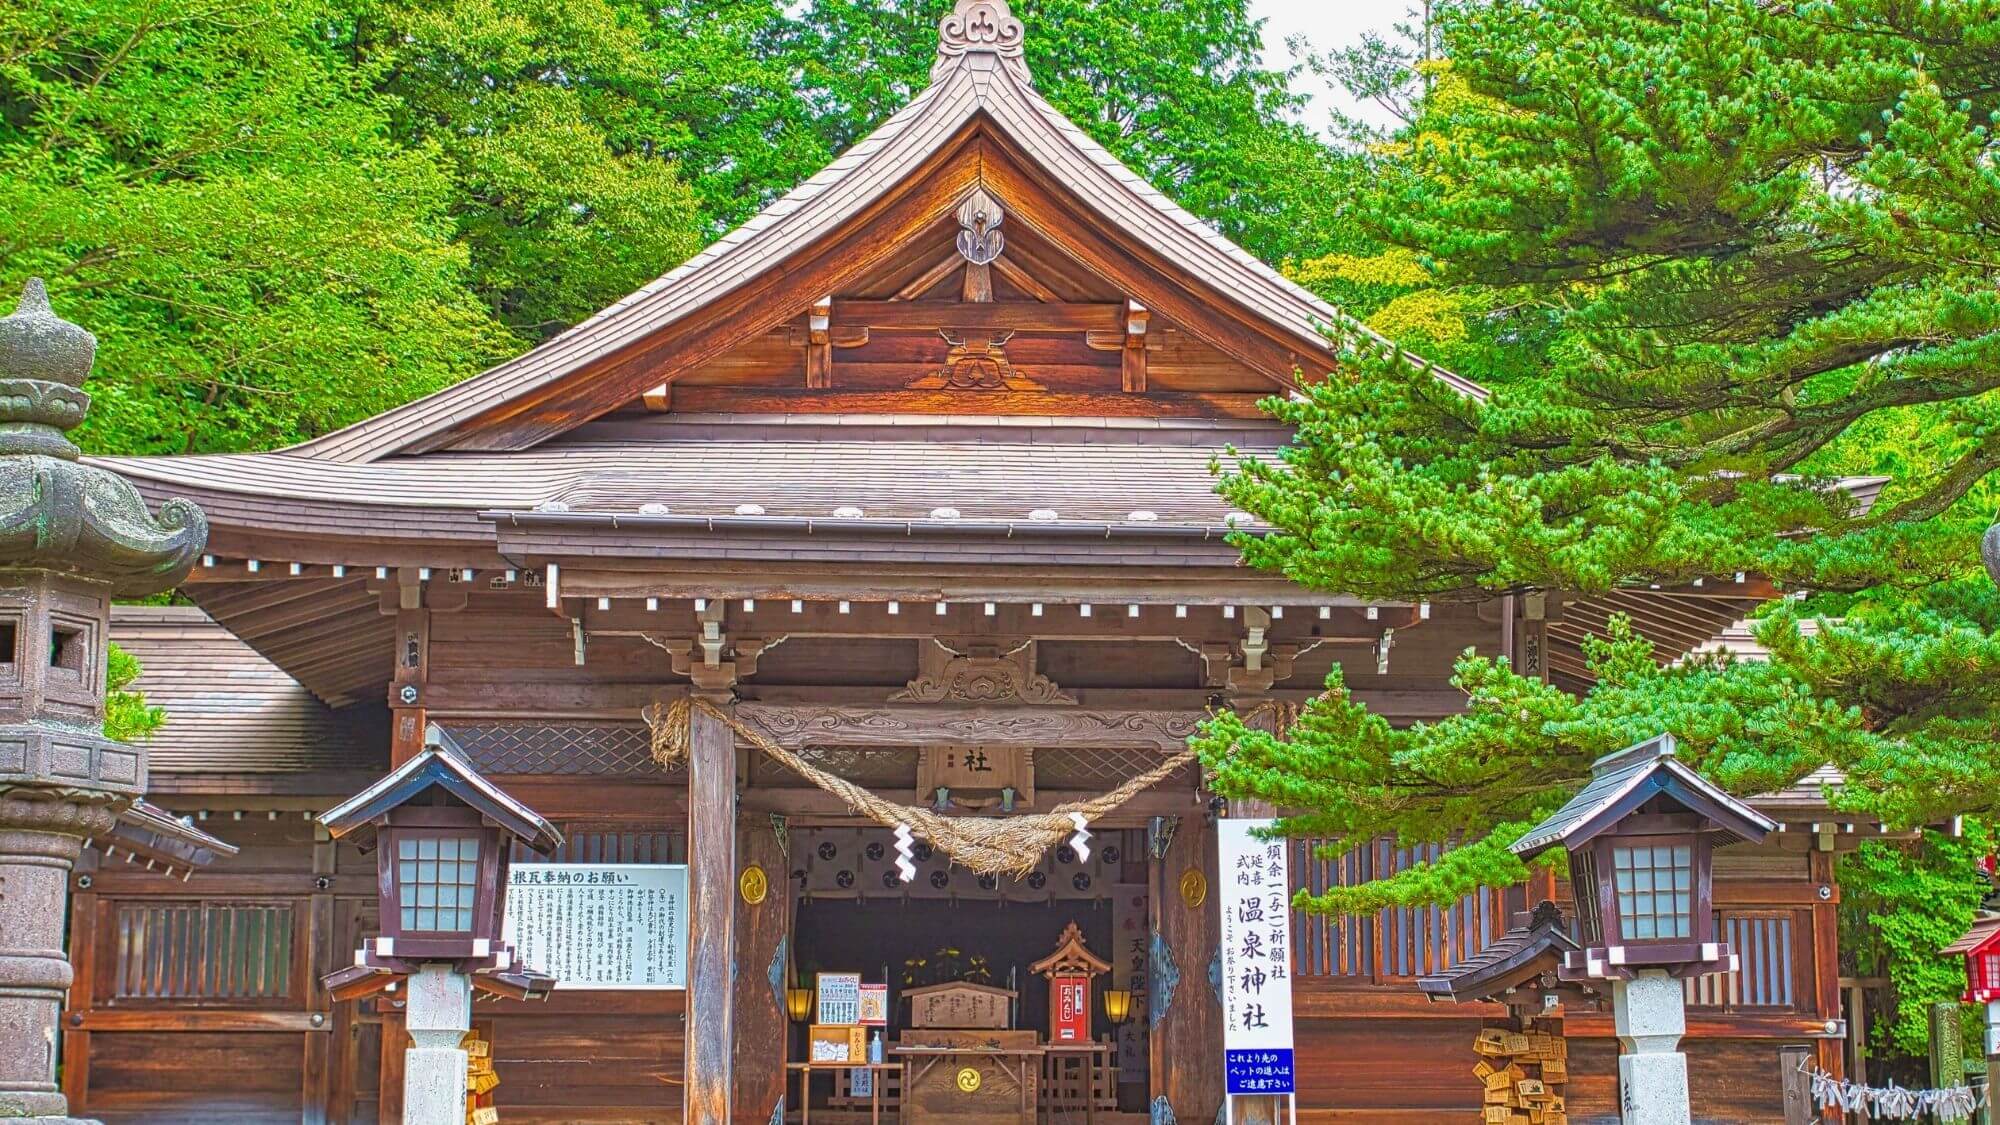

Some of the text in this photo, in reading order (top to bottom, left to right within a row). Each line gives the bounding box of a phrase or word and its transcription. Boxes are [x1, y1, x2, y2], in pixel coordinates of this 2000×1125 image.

[963, 746, 992, 772] 社
[506, 870, 629, 884] 根瓦奉納のお願い
[1237, 854, 1250, 886] 式内
[1251, 854, 1264, 886] 延喜
[1266, 838, 1286, 980] 須余一（与一）祈願社
[1130, 938, 1145, 1009] 天皇陛下
[1238, 897, 1268, 1032] 温泉神社
[1229, 1052, 1278, 1063] これより先の
